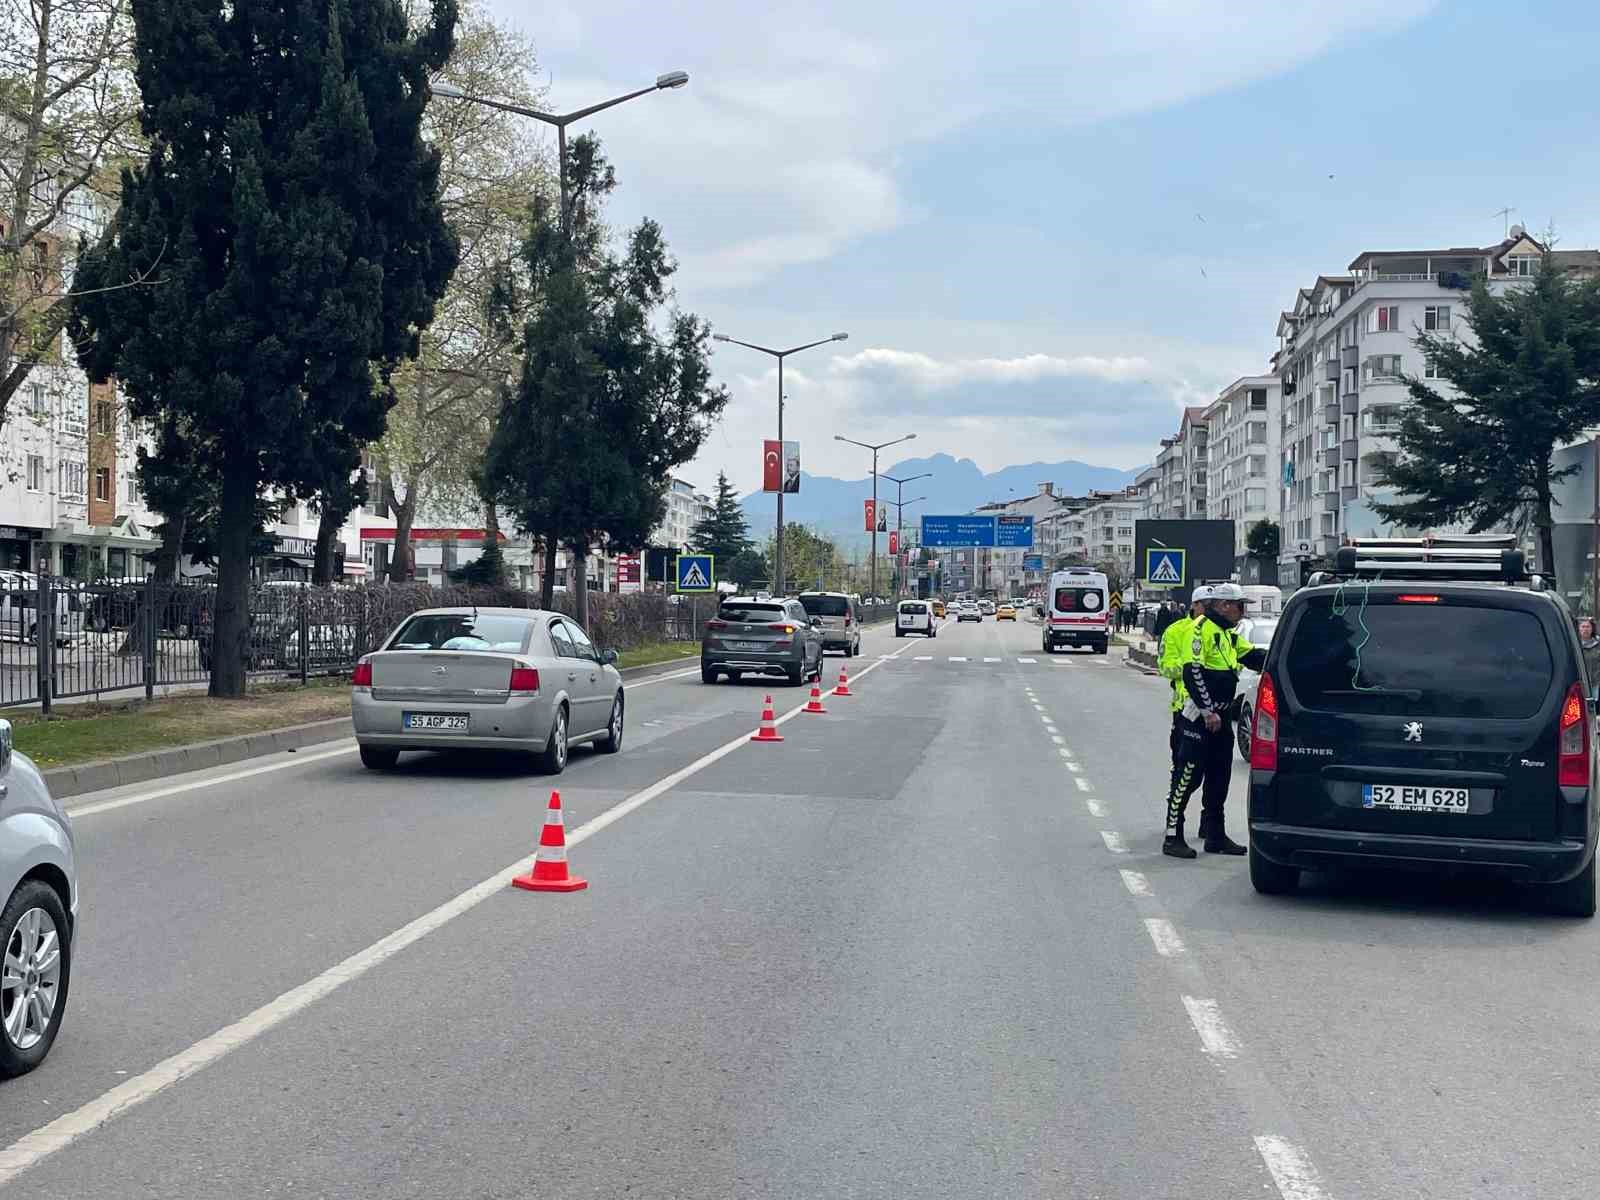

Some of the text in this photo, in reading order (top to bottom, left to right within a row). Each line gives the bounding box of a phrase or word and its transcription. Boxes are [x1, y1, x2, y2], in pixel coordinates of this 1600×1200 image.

[411, 715, 424, 727] 55
[448, 717, 467, 729] 325
[1284, 746, 1334, 756] PARTNER
[1372, 786, 1467, 807] 52 EM 628
